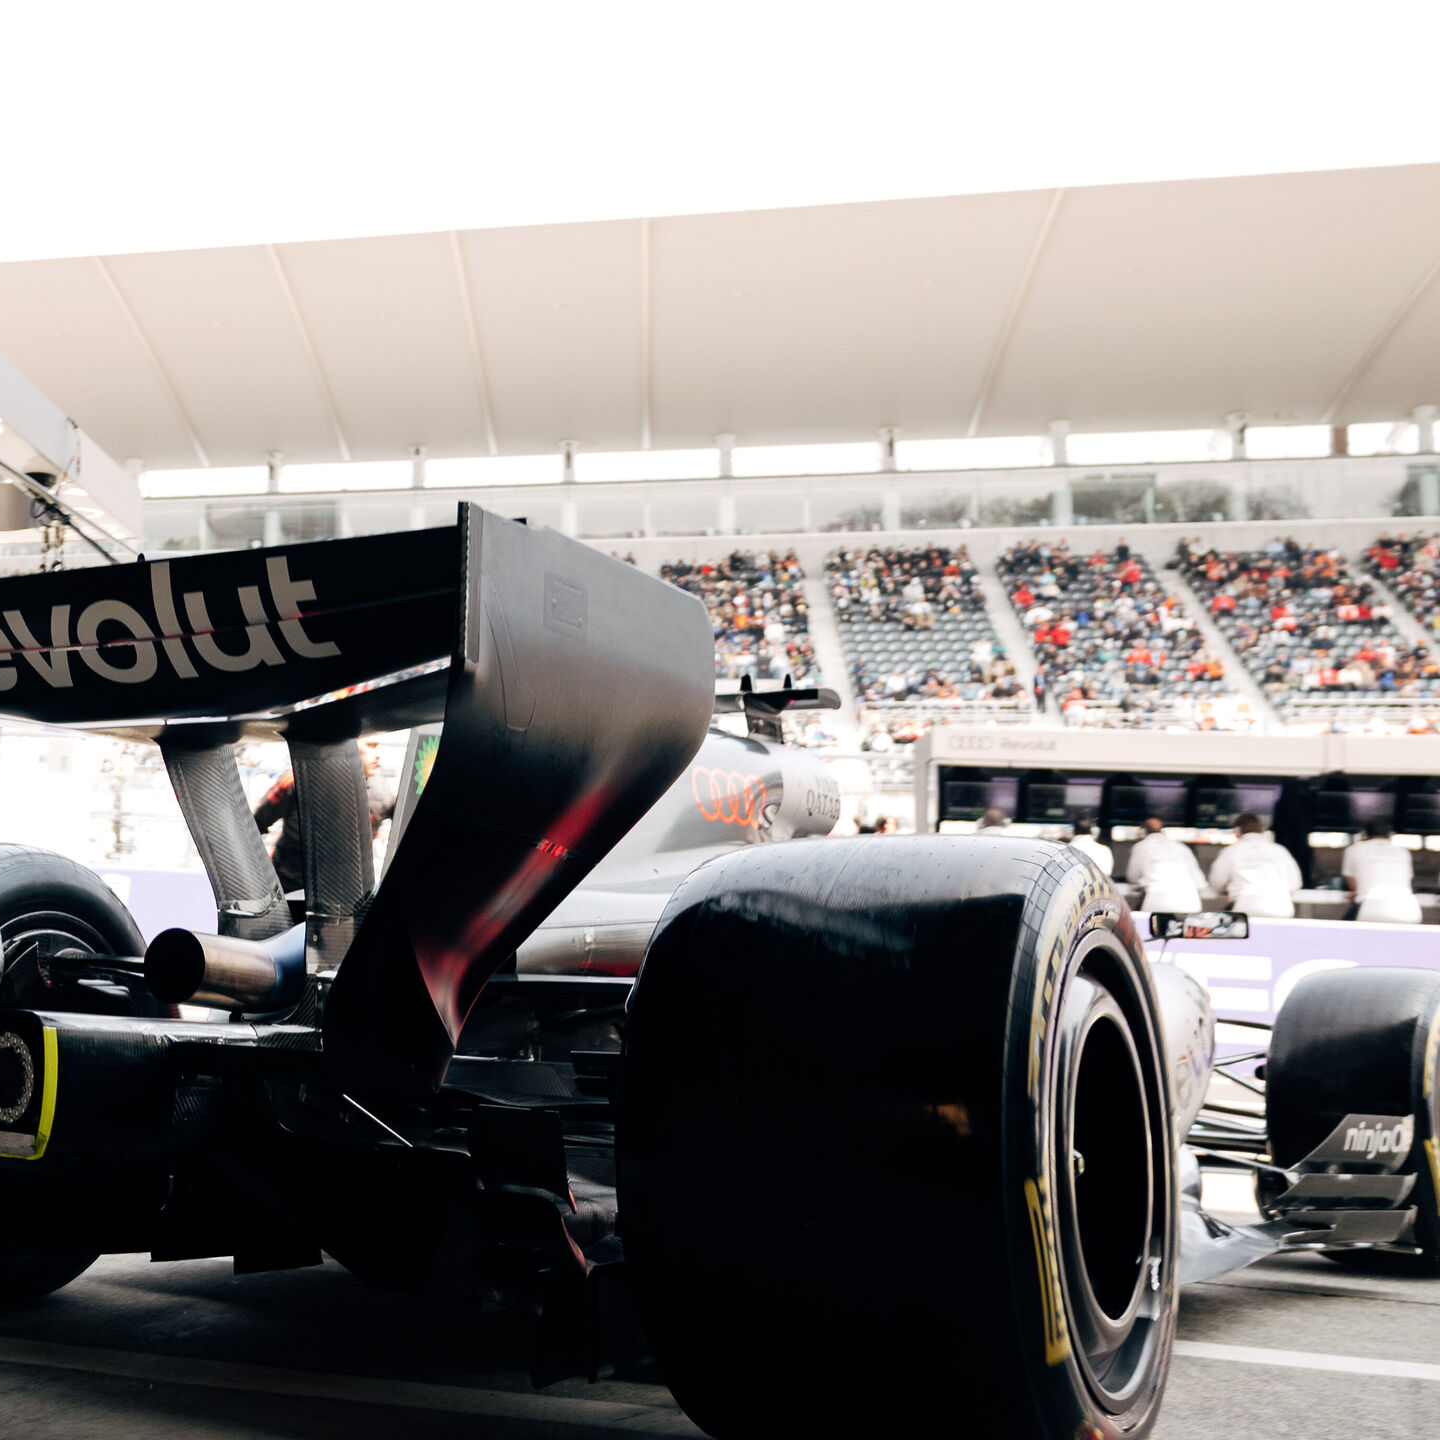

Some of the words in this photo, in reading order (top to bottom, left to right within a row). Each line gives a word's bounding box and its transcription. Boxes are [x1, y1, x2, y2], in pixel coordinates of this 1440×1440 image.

[999, 737, 1057, 751] Revolut
[806, 789, 841, 820] QATAR
[1343, 1120, 1411, 1160] ninjaO
